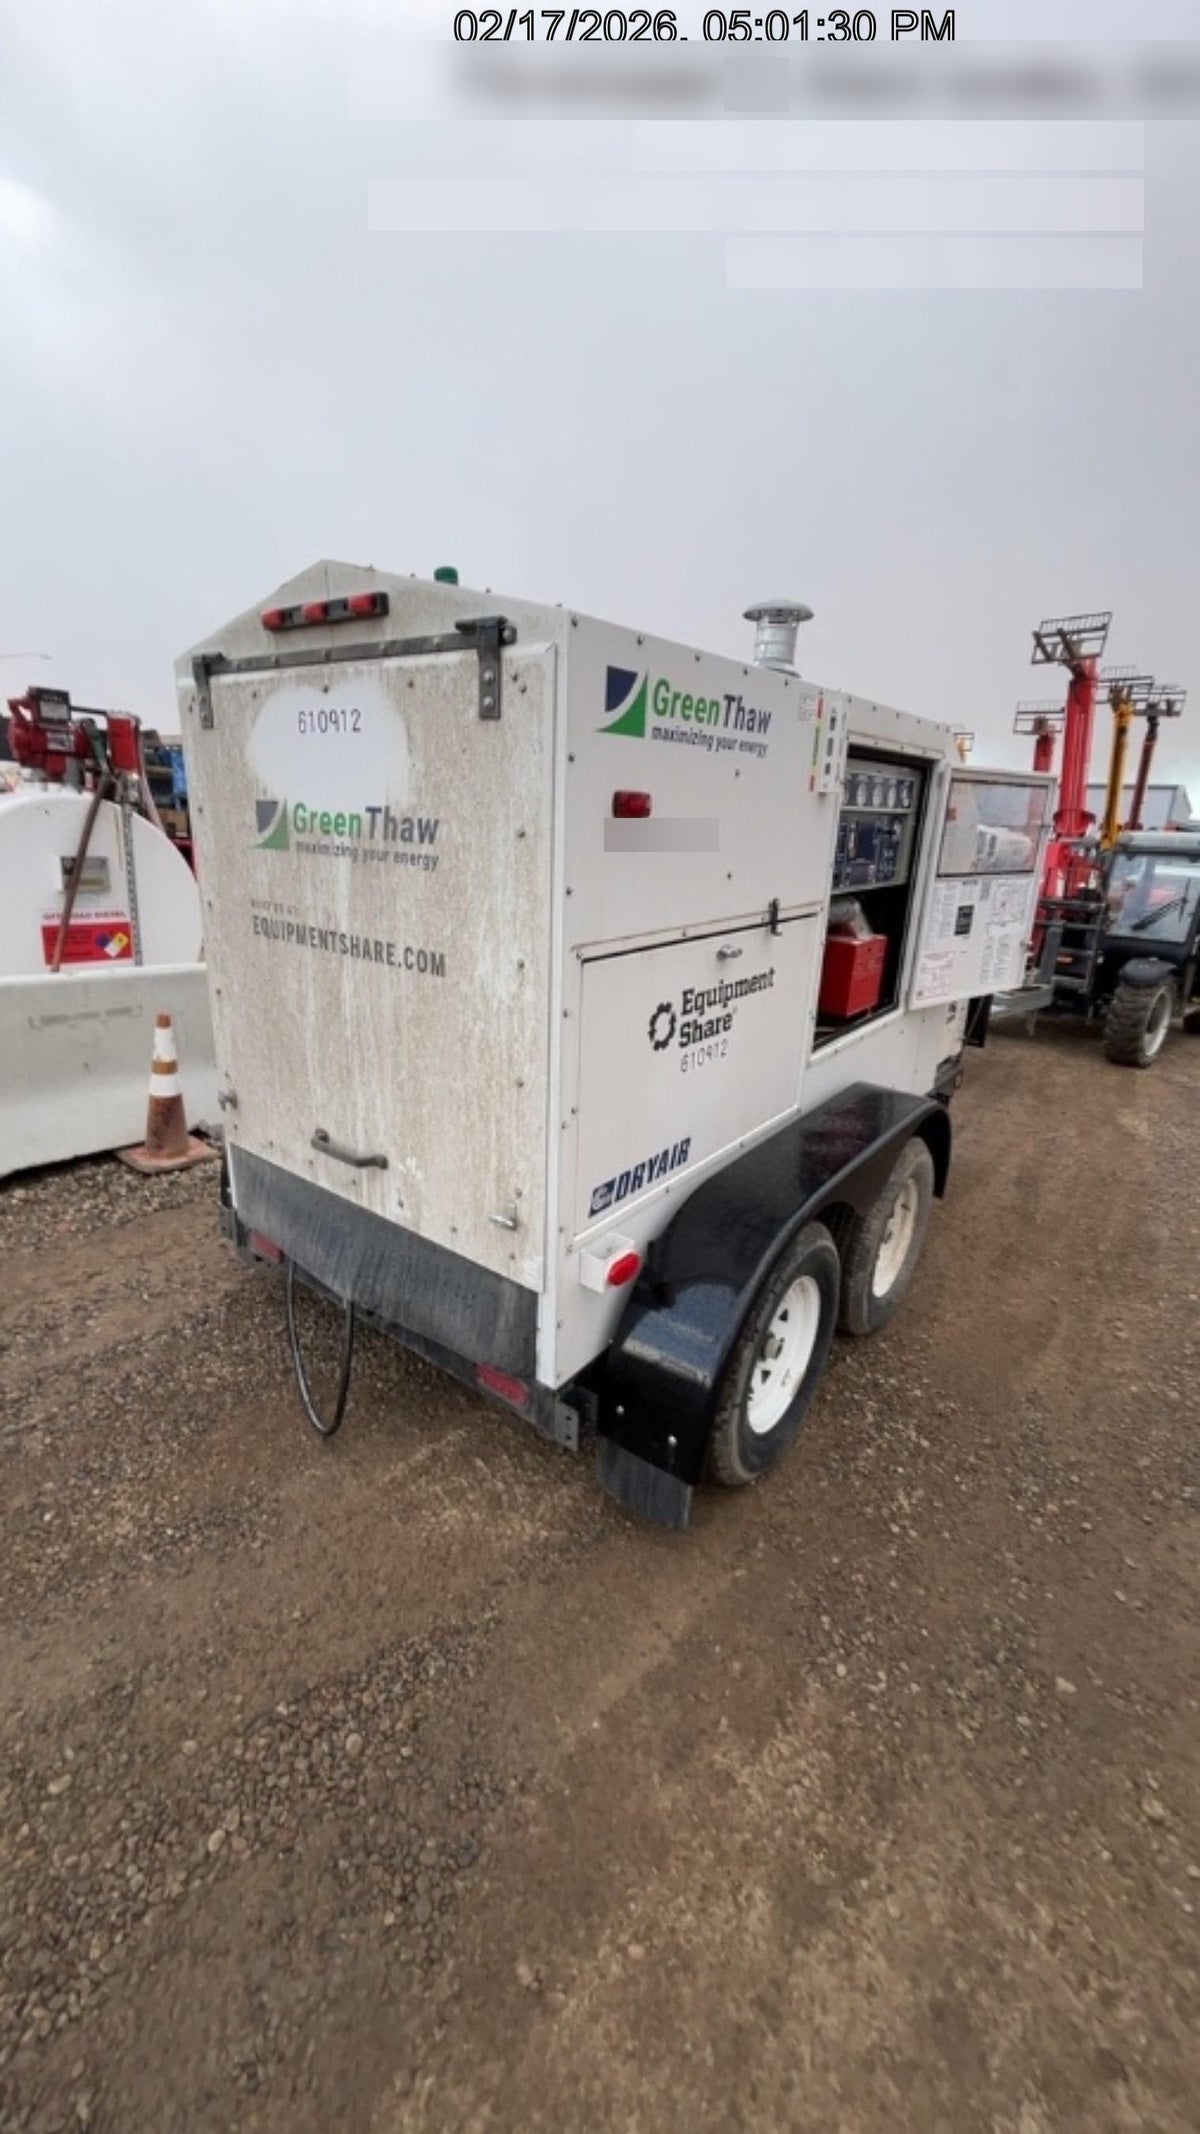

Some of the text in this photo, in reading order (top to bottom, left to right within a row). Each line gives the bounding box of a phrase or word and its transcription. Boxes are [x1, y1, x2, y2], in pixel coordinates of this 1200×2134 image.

[298, 709, 361, 733] 610912
[653, 677, 772, 734] GreenThaw
[652, 725, 768, 758] maximizing your energy
[293, 802, 439, 845] GreenThaw
[361, 849, 390, 864] your
[394, 852, 439, 872] energy
[252, 915, 447, 978] EQUIPMENTSHARE.COM
[680, 967, 776, 1016] Equipment
[679, 1012, 733, 1048] Share
[680, 1038, 728, 1073] 610912
[614, 1137, 691, 1203] DRYAIR
